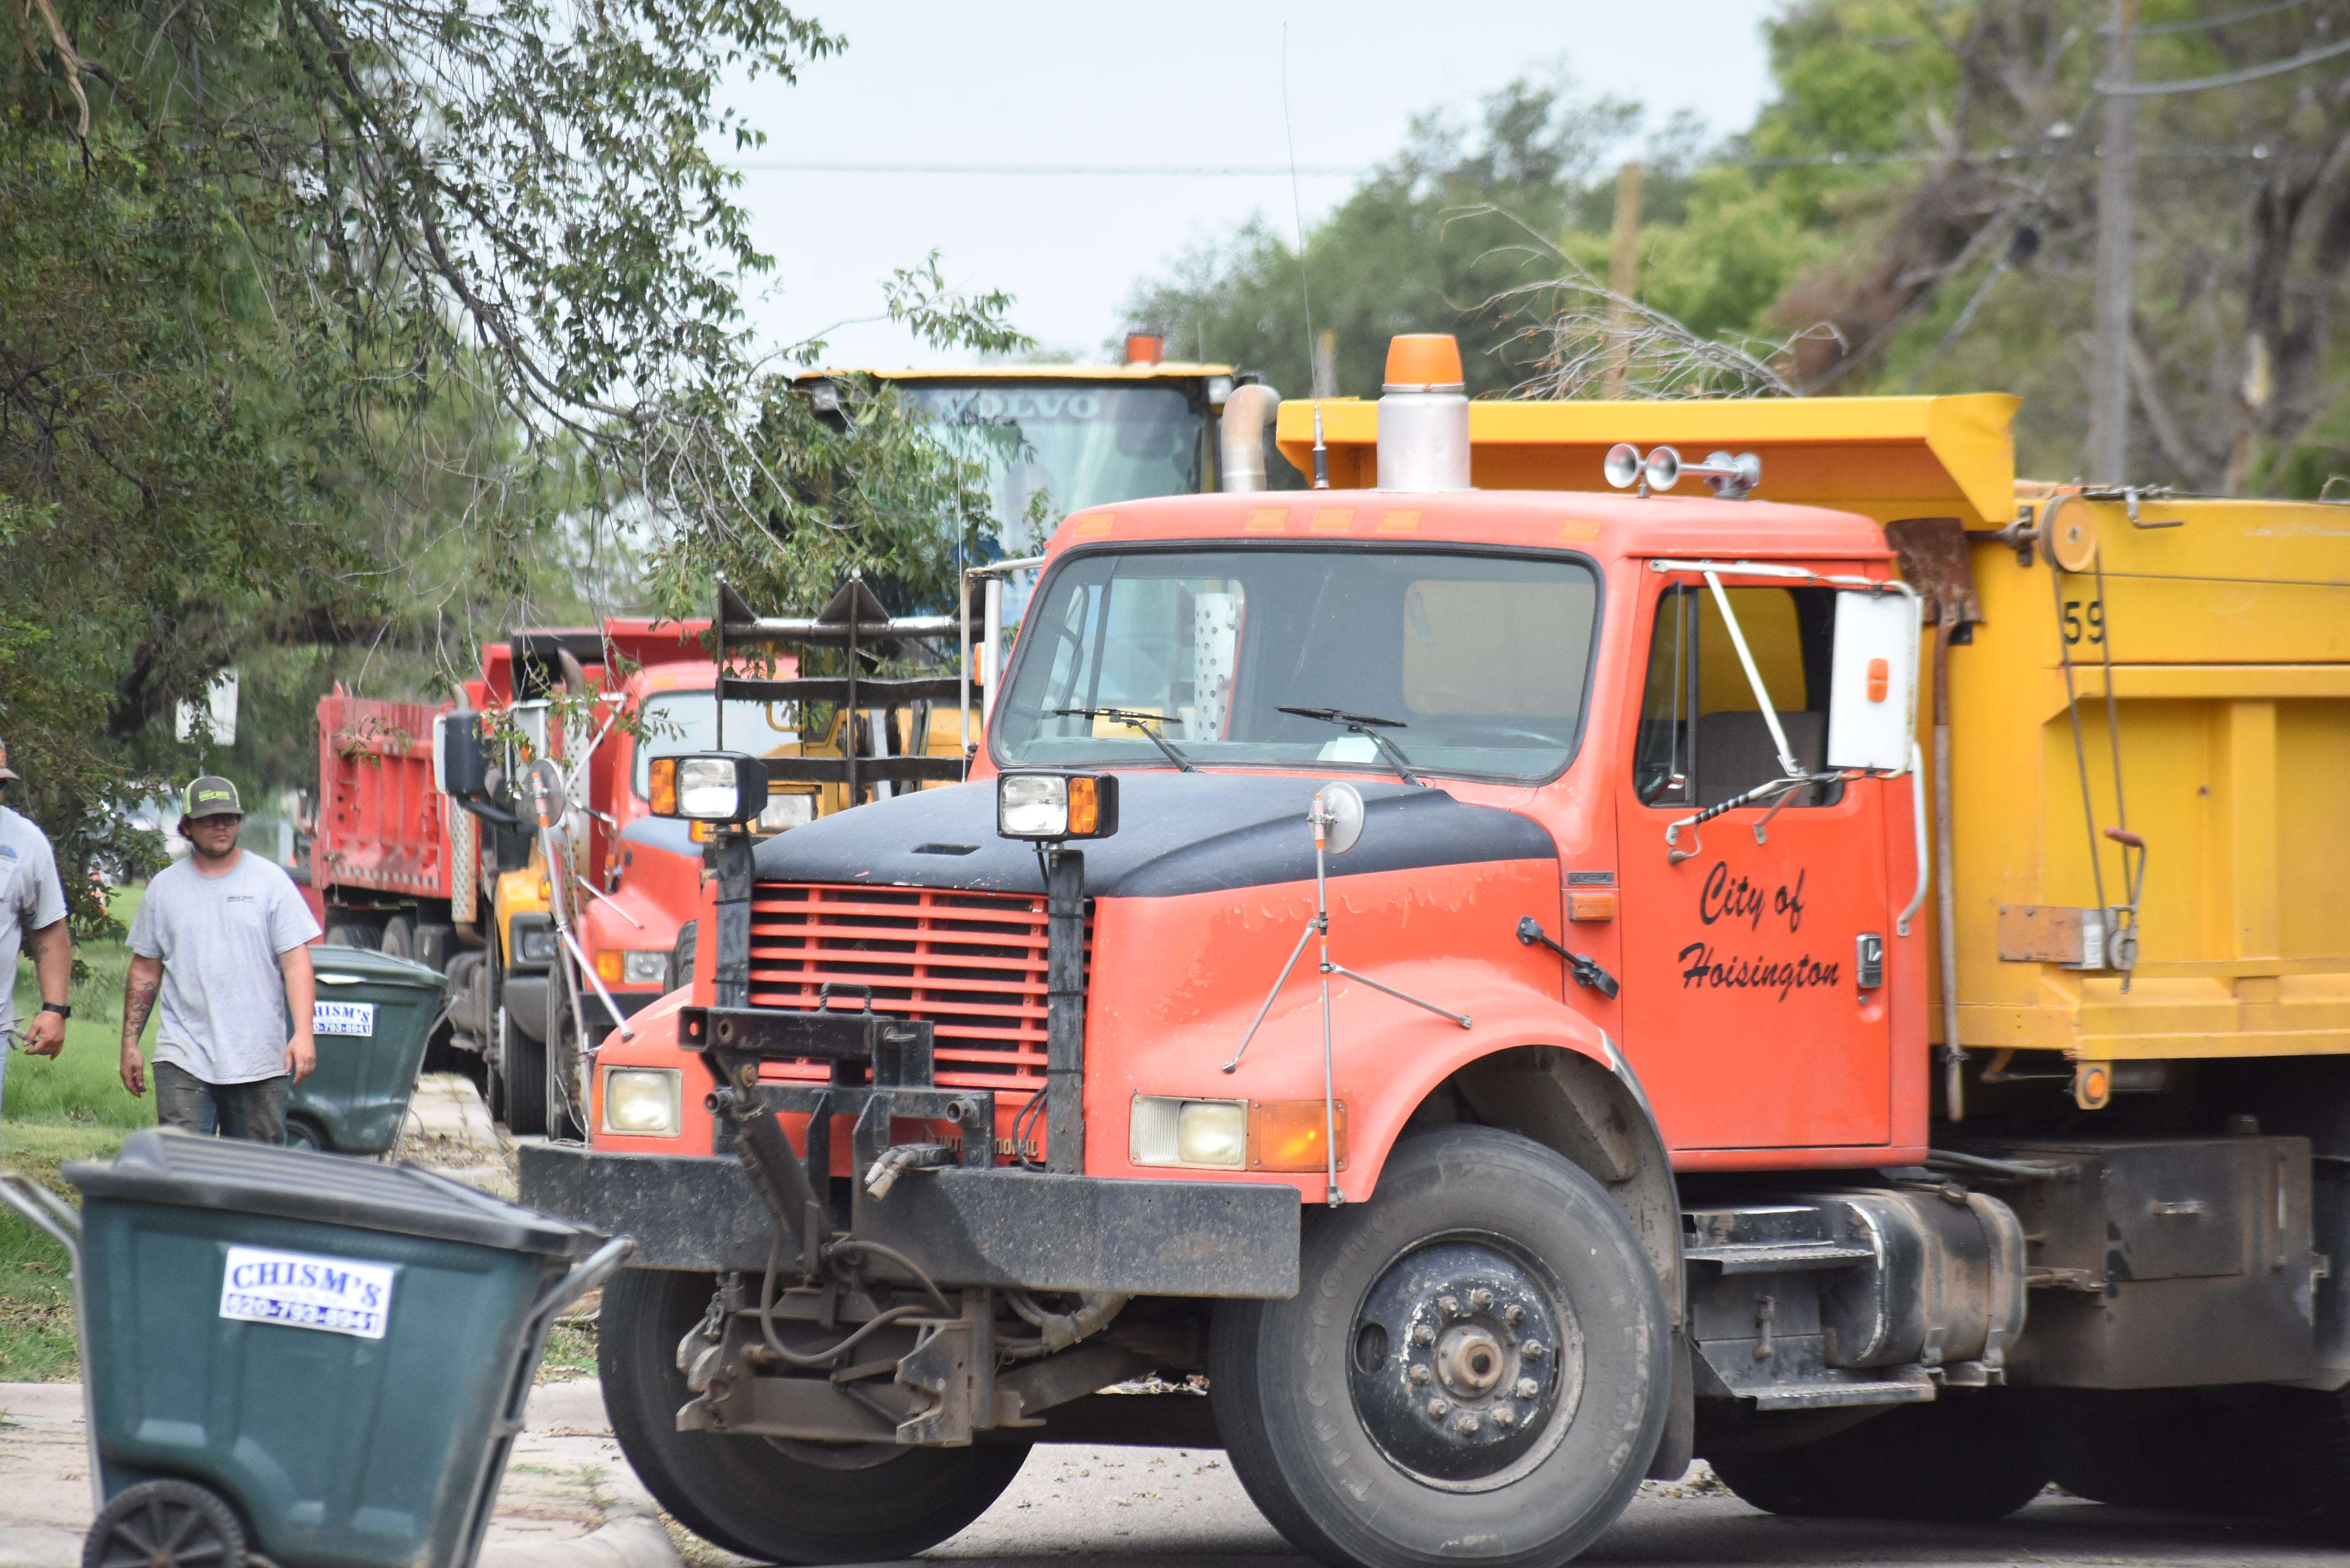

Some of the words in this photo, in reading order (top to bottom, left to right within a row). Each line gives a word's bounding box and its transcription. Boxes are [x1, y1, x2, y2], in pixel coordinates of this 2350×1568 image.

[931, 393, 1099, 419] VOLVO
[2064, 601, 2105, 645] 59
[1700, 861, 1765, 932] City
[1774, 867, 1805, 933] of
[1678, 942, 1839, 1003] Hoisington
[314, 1006, 370, 1022] HISM'S
[233, 1263, 382, 1307] CHISM'S
